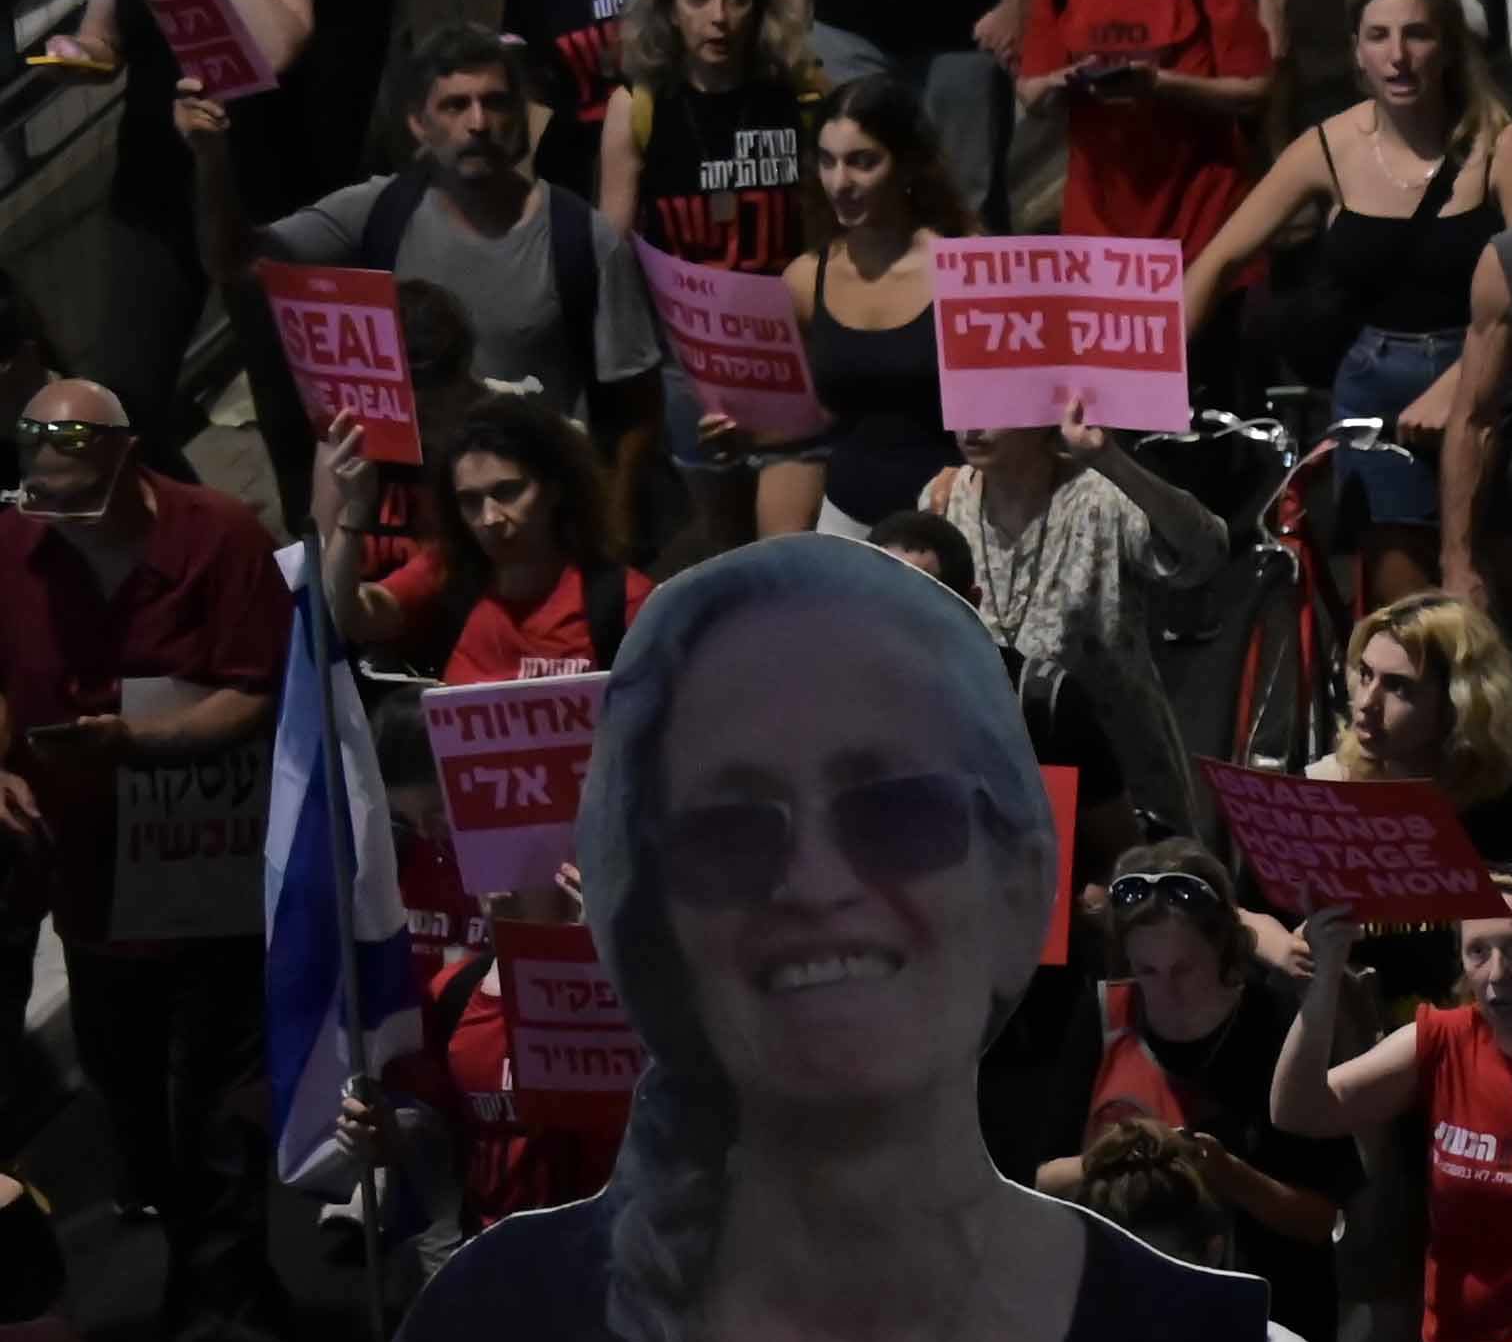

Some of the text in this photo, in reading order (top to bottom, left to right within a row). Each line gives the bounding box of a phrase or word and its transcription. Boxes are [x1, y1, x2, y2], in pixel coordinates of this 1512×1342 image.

[1103, 248, 1178, 293] קול
[280, 305, 396, 373] SEAL
[719, 313, 791, 346] נשים
[953, 309, 1168, 356] זועק אלי
[460, 764, 554, 810] אלי
[1208, 762, 1360, 814] ISRAEL
[1224, 802, 1436, 841] DEMANDS
[1240, 827, 1439, 868] HOSTAGE
[1374, 869, 1482, 898] NOW
